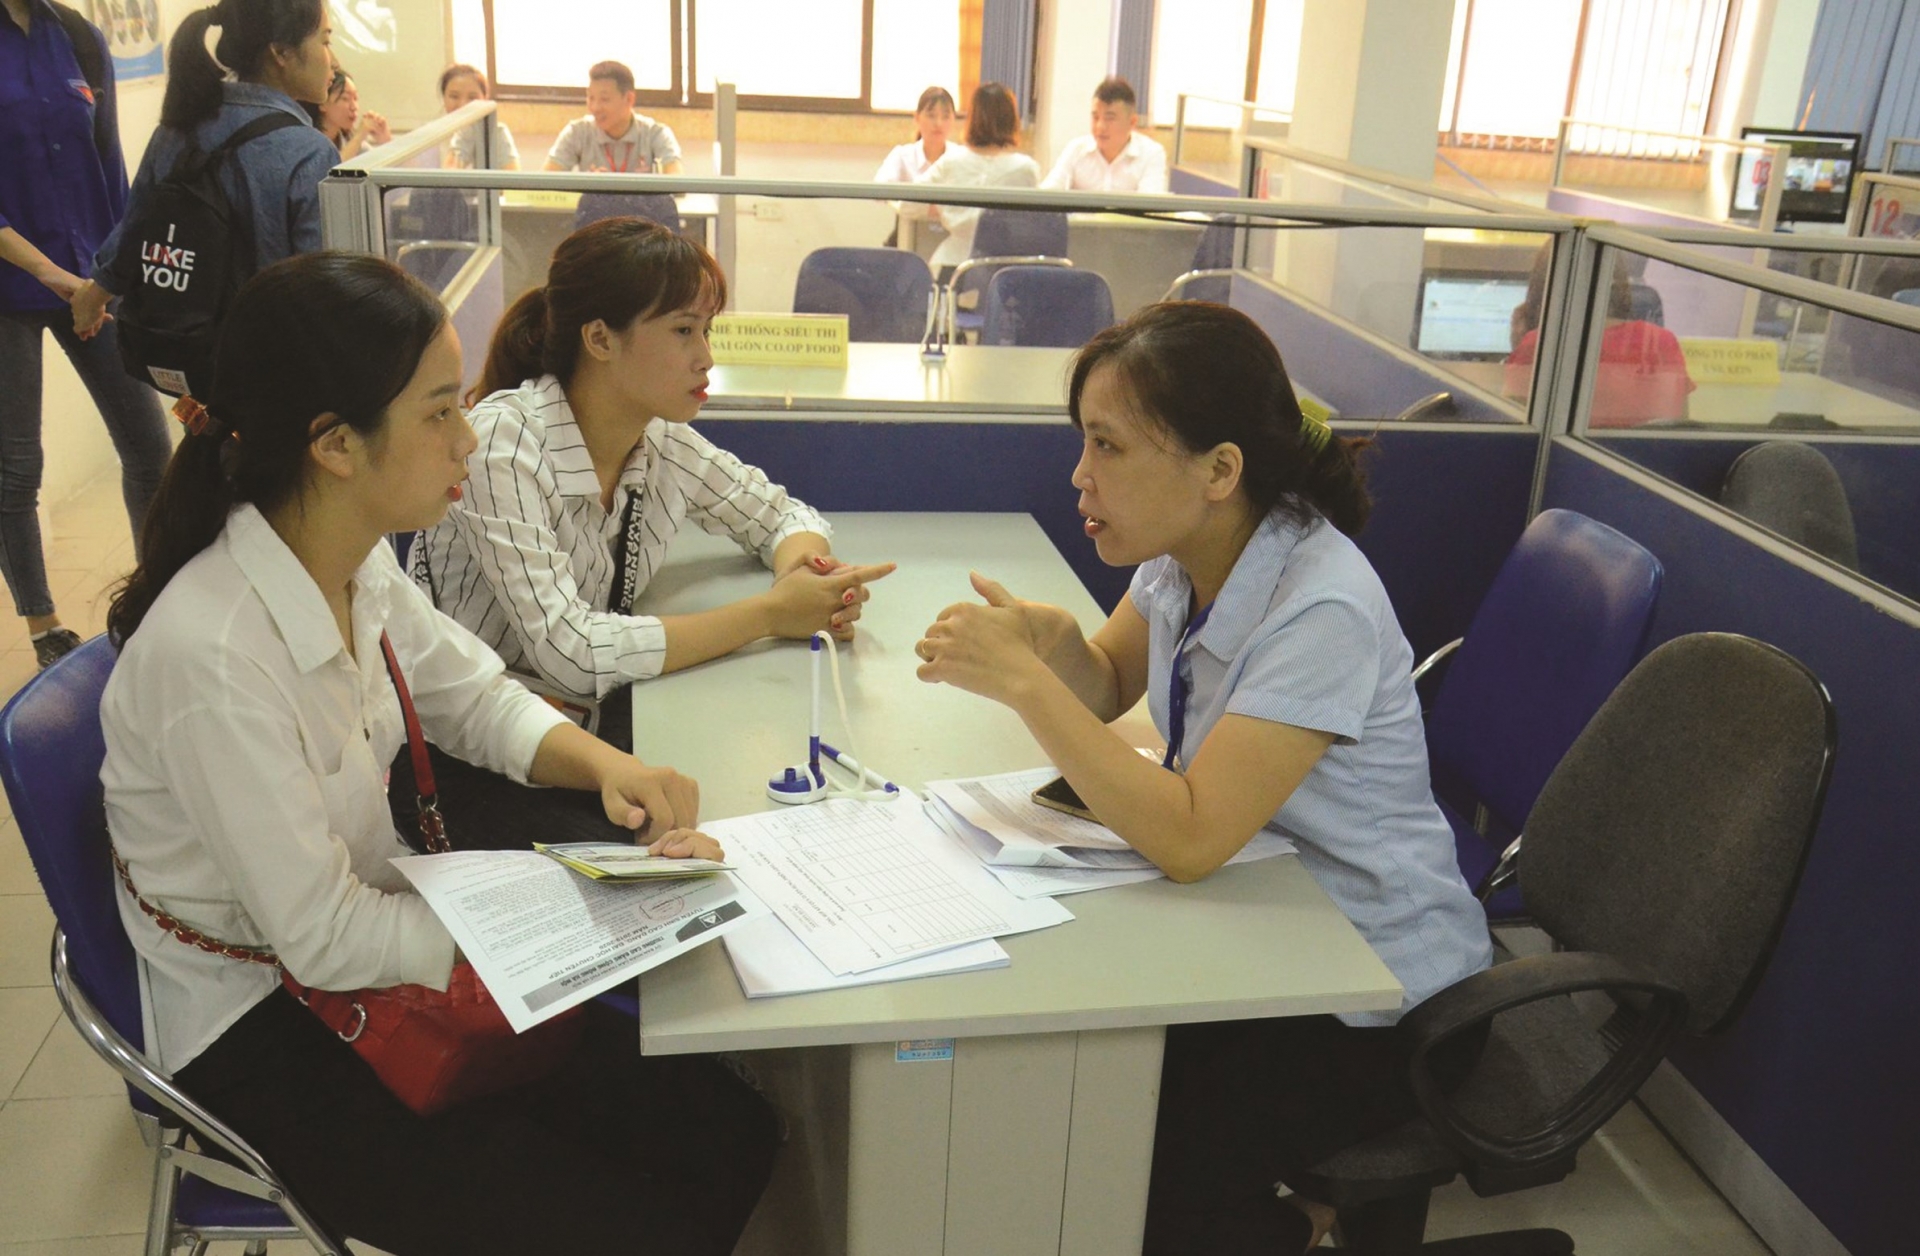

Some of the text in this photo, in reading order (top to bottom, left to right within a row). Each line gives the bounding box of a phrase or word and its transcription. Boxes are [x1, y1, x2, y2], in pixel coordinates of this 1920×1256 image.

[1872, 198, 1900, 237] 12
[167, 223, 176, 243] I
[142, 263, 190, 292] YOU
[806, 343, 841, 355] FOOD
[662, 915, 680, 927] SINH
[646, 923, 663, 935] CAO
[629, 945, 642, 955] CAO
